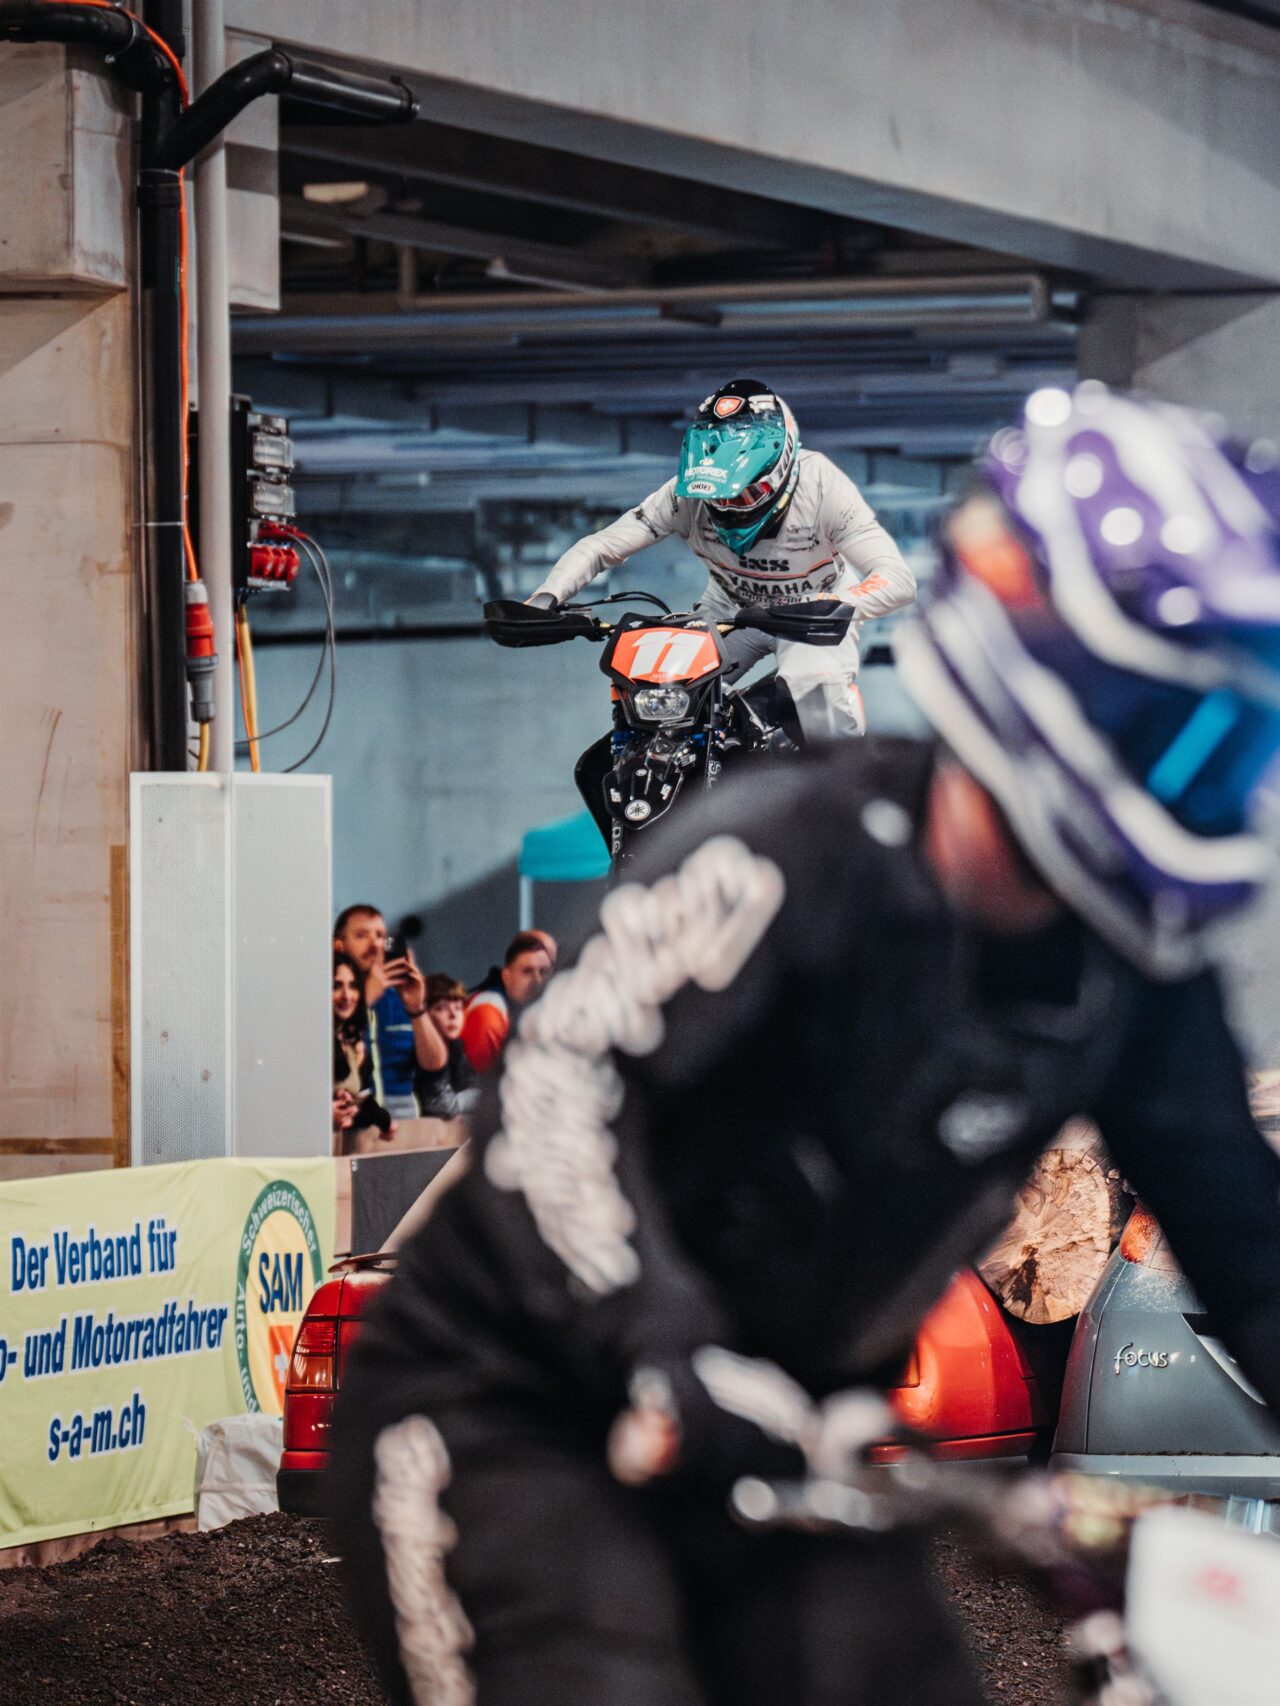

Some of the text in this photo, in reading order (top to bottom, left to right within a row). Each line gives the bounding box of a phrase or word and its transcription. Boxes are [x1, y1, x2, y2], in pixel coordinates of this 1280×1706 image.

[728, 573, 814, 596] YAMAHA
[631, 631, 707, 679] 11
[11, 1218, 178, 1292] Der Verband für
[242, 1185, 317, 1256] Schweizerischer
[258, 1251, 304, 1315] SAM
[24, 1318, 68, 1379] und
[71, 1300, 229, 1371] Motorradfahrer
[236, 1281, 247, 1361] Auto-
[48, 1393, 147, 1463] s-a-m.ch
